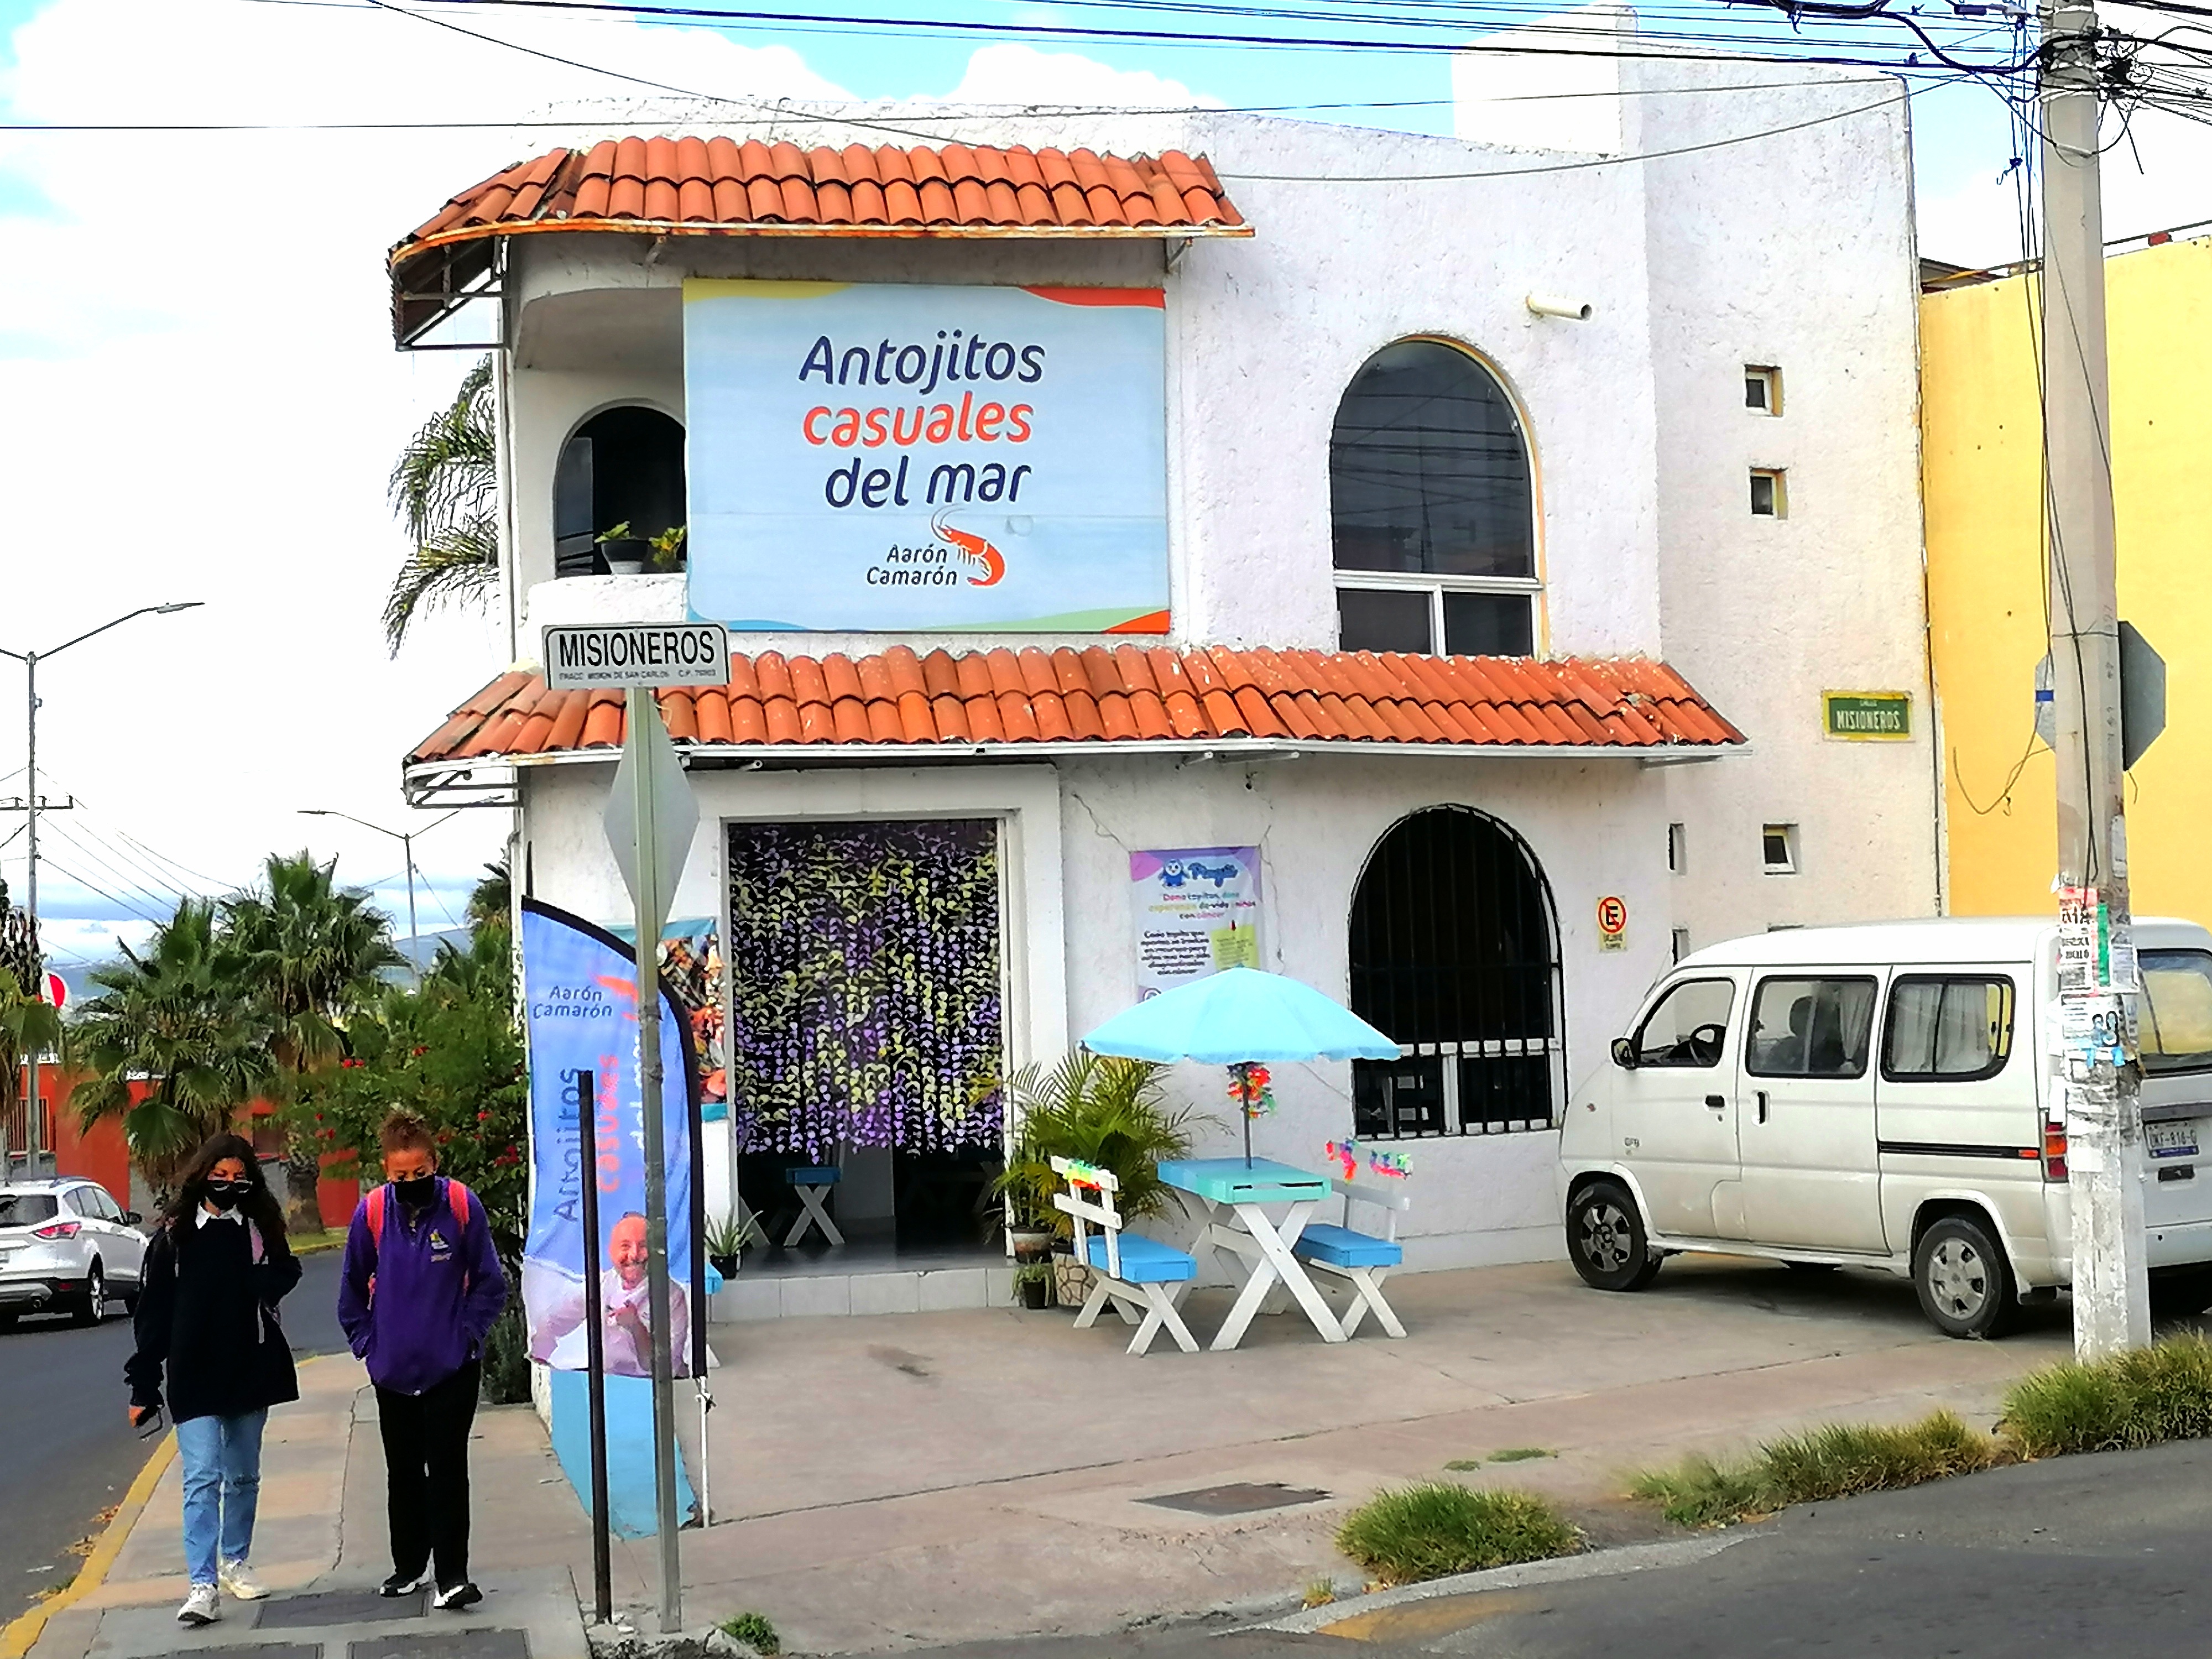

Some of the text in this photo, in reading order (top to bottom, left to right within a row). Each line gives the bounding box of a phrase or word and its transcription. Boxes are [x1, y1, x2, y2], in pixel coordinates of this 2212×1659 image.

[799, 329, 1045, 395] Antojitos
[804, 391, 1034, 447] casuales
[825, 455, 1032, 508] del mar
[886, 543, 948, 564] Aarón
[867, 565, 958, 586] Camarón
[559, 630, 714, 667] MISIONEROS
[1836, 710, 1901, 730] MISIONEROS
[1605, 906, 1619, 926] E
[549, 985, 603, 1002] Aarón
[533, 1003, 613, 1019] Camarón
